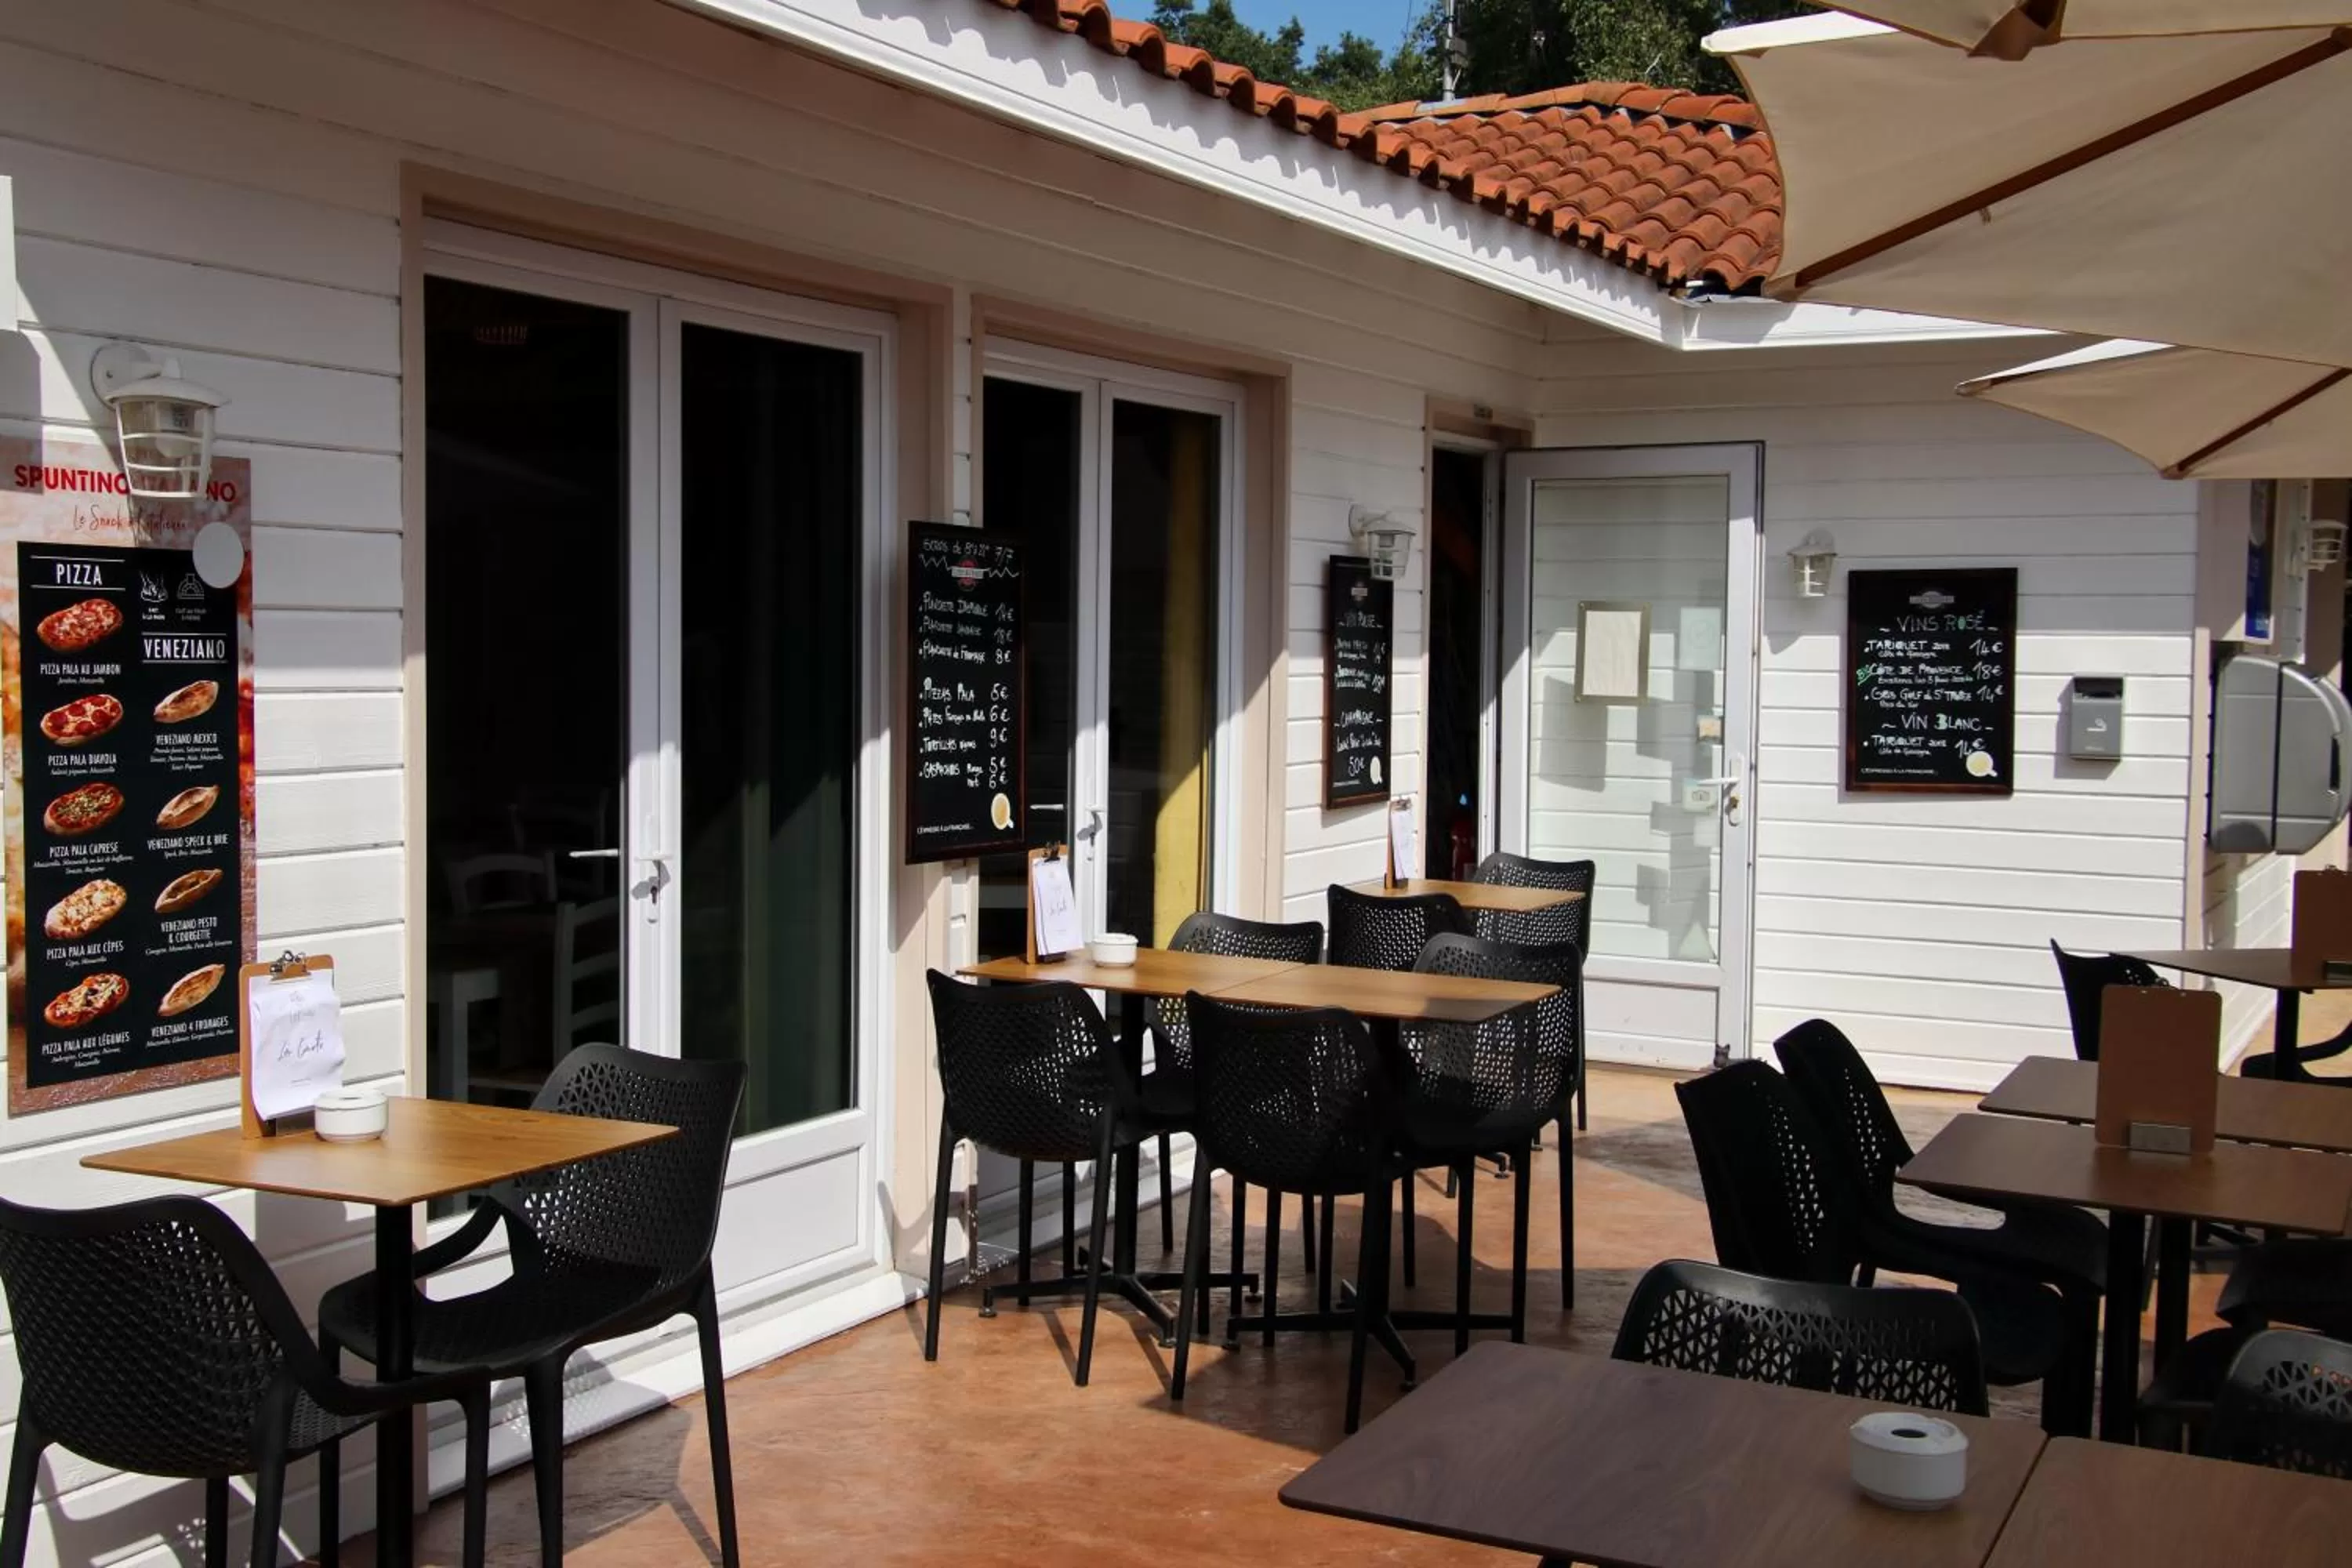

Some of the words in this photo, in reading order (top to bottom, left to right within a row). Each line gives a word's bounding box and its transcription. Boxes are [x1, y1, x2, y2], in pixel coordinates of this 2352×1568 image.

[15, 464, 130, 495] SPUNTINO
[56, 564, 103, 586] PIZZA
[1896, 615, 1938, 632] VINS
[143, 639, 226, 659] VENEZIANO
[1969, 638, 2004, 657] 14€
[40, 663, 60, 675] PIZZA
[63, 663, 78, 675] PALA
[93, 664, 121, 675] JAMBON
[1973, 661, 2002, 680] 18€
[1976, 684, 2004, 702] 14€
[1901, 712, 1928, 730] VIN
[1934, 713, 1982, 731] BLANC
[155, 734, 191, 744] VENEZIANO
[193, 733, 217, 744] MEXICO
[48, 755, 68, 766] PIZZA
[70, 754, 87, 766] PALA
[89, 753, 117, 764] DIAVOLA
[49, 846, 70, 858] PIZZA
[71, 844, 88, 856] PALA
[89, 841, 119, 855] CAPRESE
[147, 837, 183, 850] VENEZIANO
[185, 836, 205, 847] SPECK
[161, 918, 196, 932] VENEZIANO
[198, 916, 218, 928] PESTO
[176, 929, 211, 942] COURGETTE
[46, 947, 67, 960] PIZZA
[68, 946, 85, 957] PALA
[87, 944, 101, 954] AUX
[151, 1022, 187, 1037] VENEZIANO
[195, 1016, 229, 1030] FROMAGES
[42, 1043, 62, 1055] PIZZA
[64, 1040, 81, 1051] PALA
[82, 1036, 96, 1048] AUX
[98, 1032, 130, 1047] LÉGUMES
